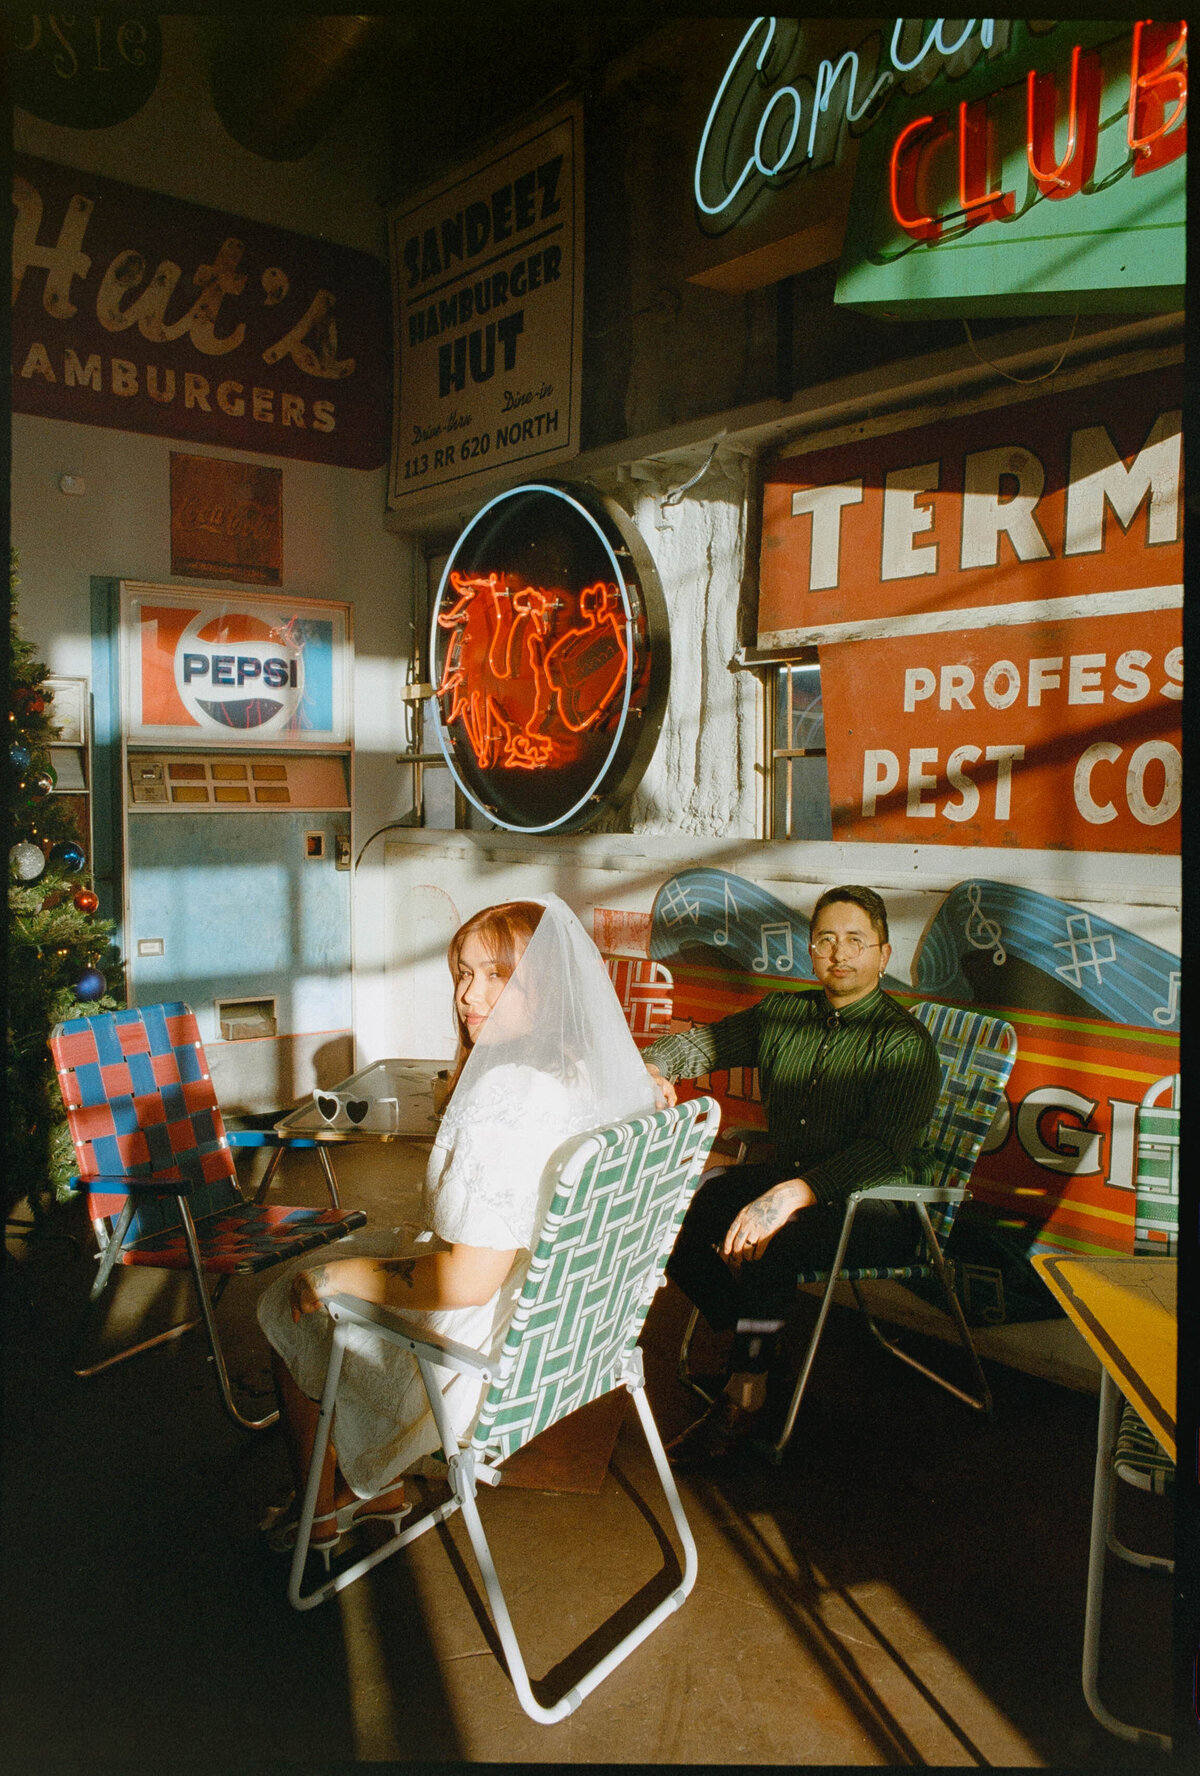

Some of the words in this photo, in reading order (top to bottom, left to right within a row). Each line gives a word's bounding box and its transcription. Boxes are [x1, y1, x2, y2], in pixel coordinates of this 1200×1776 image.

[890, 18, 1188, 240] CLUB
[403, 152, 566, 289] SANDEEZ
[408, 244, 563, 348] HAMBURGER
[11, 342, 337, 434] AMBURGERS
[438, 309, 526, 399] HUT
[501, 381, 554, 413] Dine-in
[403, 454, 430, 480] 113
[434, 445, 456, 470] RR
[460, 433, 491, 461] 620
[496, 408, 559, 450] NORTH
[790, 407, 1183, 592] TERM
[182, 652, 298, 690] PEPSI
[861, 743, 1026, 823] PEST
[1073, 739, 1182, 827] CO
